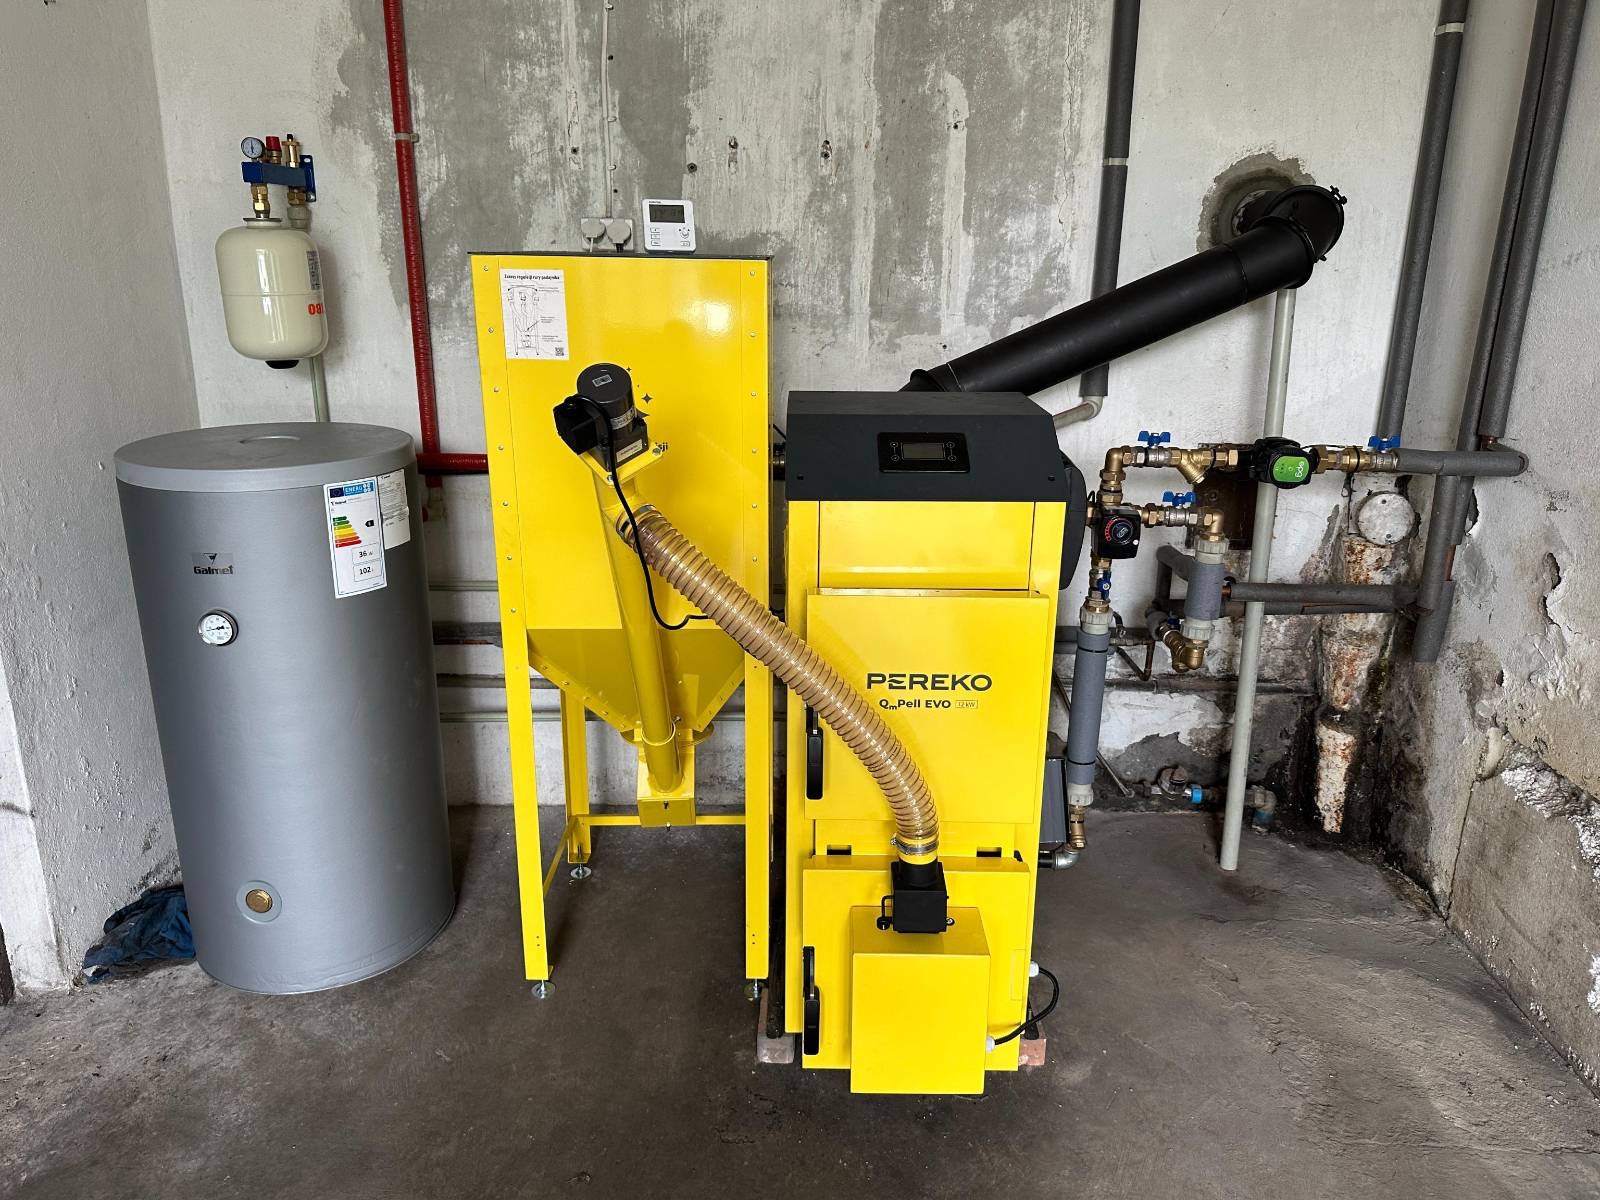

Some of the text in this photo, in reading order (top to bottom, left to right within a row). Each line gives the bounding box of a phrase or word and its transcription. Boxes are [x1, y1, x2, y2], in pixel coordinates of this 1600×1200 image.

[359, 550, 368, 558] 36
[193, 565, 234, 574] Galmet
[359, 566, 371, 575] 102
[867, 673, 993, 691] PEREKO
[925, 700, 951, 708] EVO
